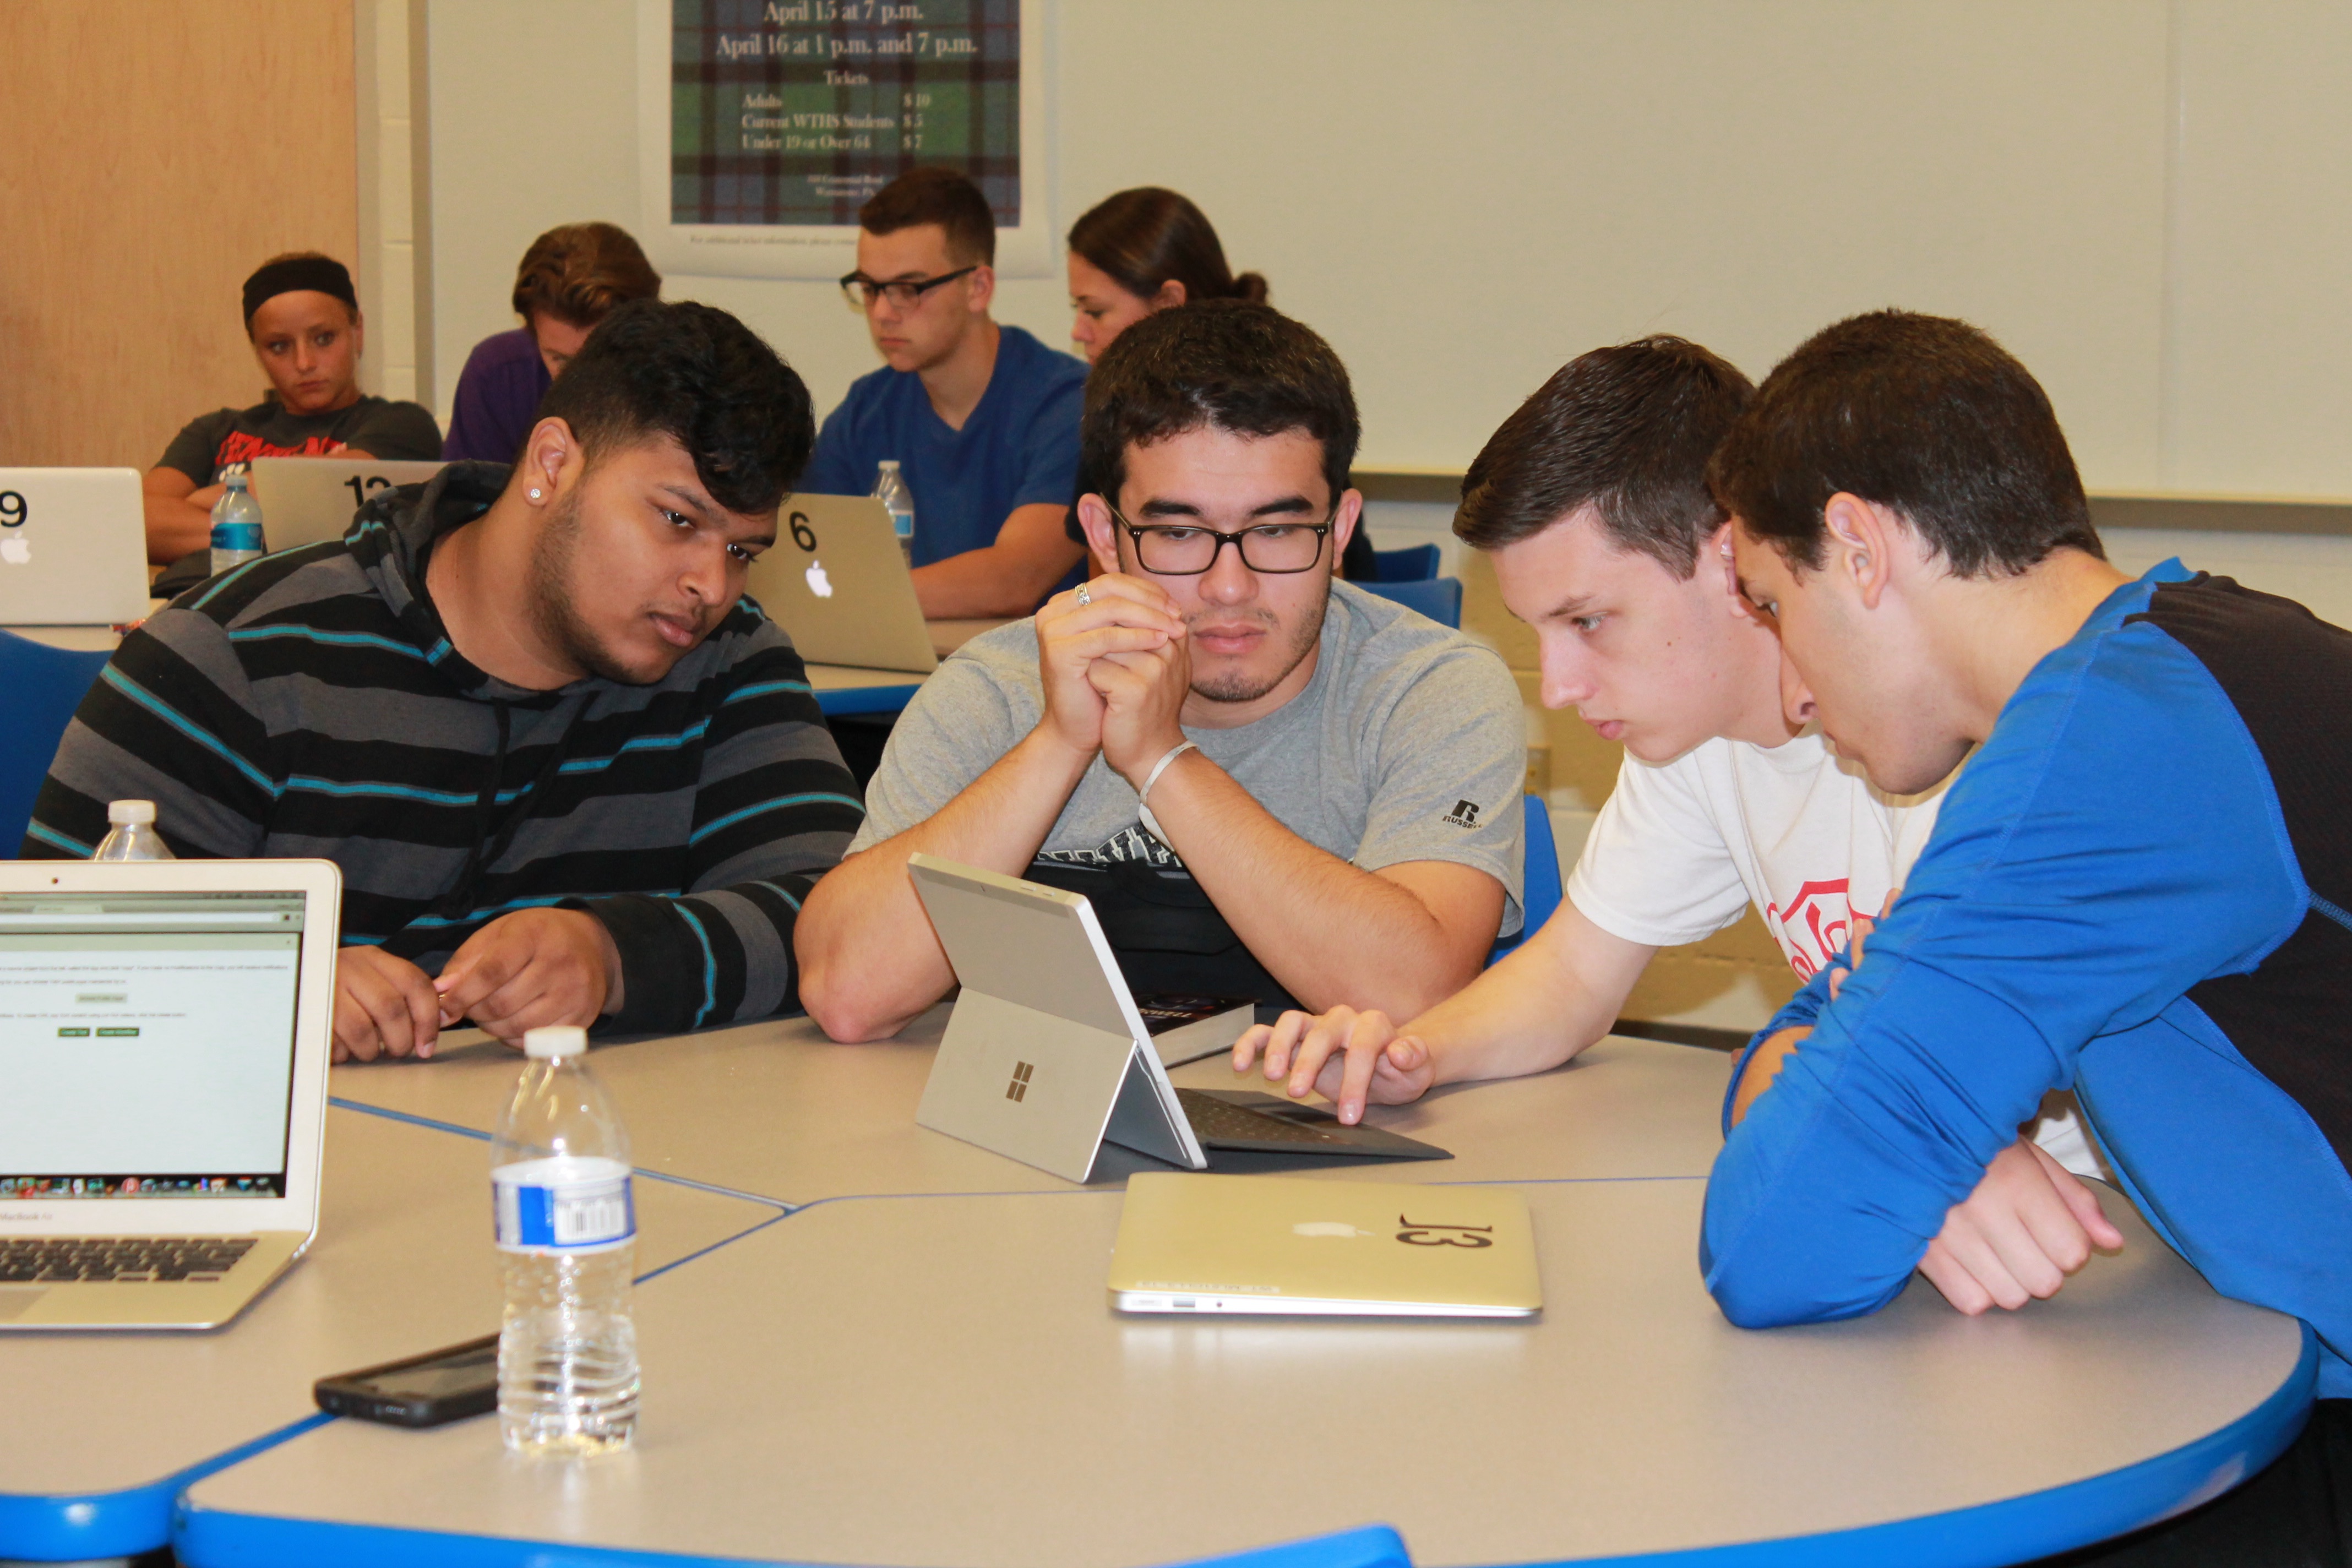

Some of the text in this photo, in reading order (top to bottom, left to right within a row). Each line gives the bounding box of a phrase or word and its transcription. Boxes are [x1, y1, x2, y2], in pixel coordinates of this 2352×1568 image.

[764, 0, 924, 25] April 15 at 7 p.m.
[716, 31, 978, 59] April 16 at 1 p.m. and 7 p.m.
[823, 70, 869, 85] Tickets
[743, 93, 782, 107] Adults
[742, 114, 790, 129] Current
[793, 114, 840, 129] WTHS
[843, 113, 896, 129] Students
[743, 134, 781, 149] Under
[786, 135, 801, 149] 19
[803, 139, 816, 149] or
[820, 134, 852, 149] Over
[0, 491, 28, 528] 9
[789, 510, 817, 552] 6
